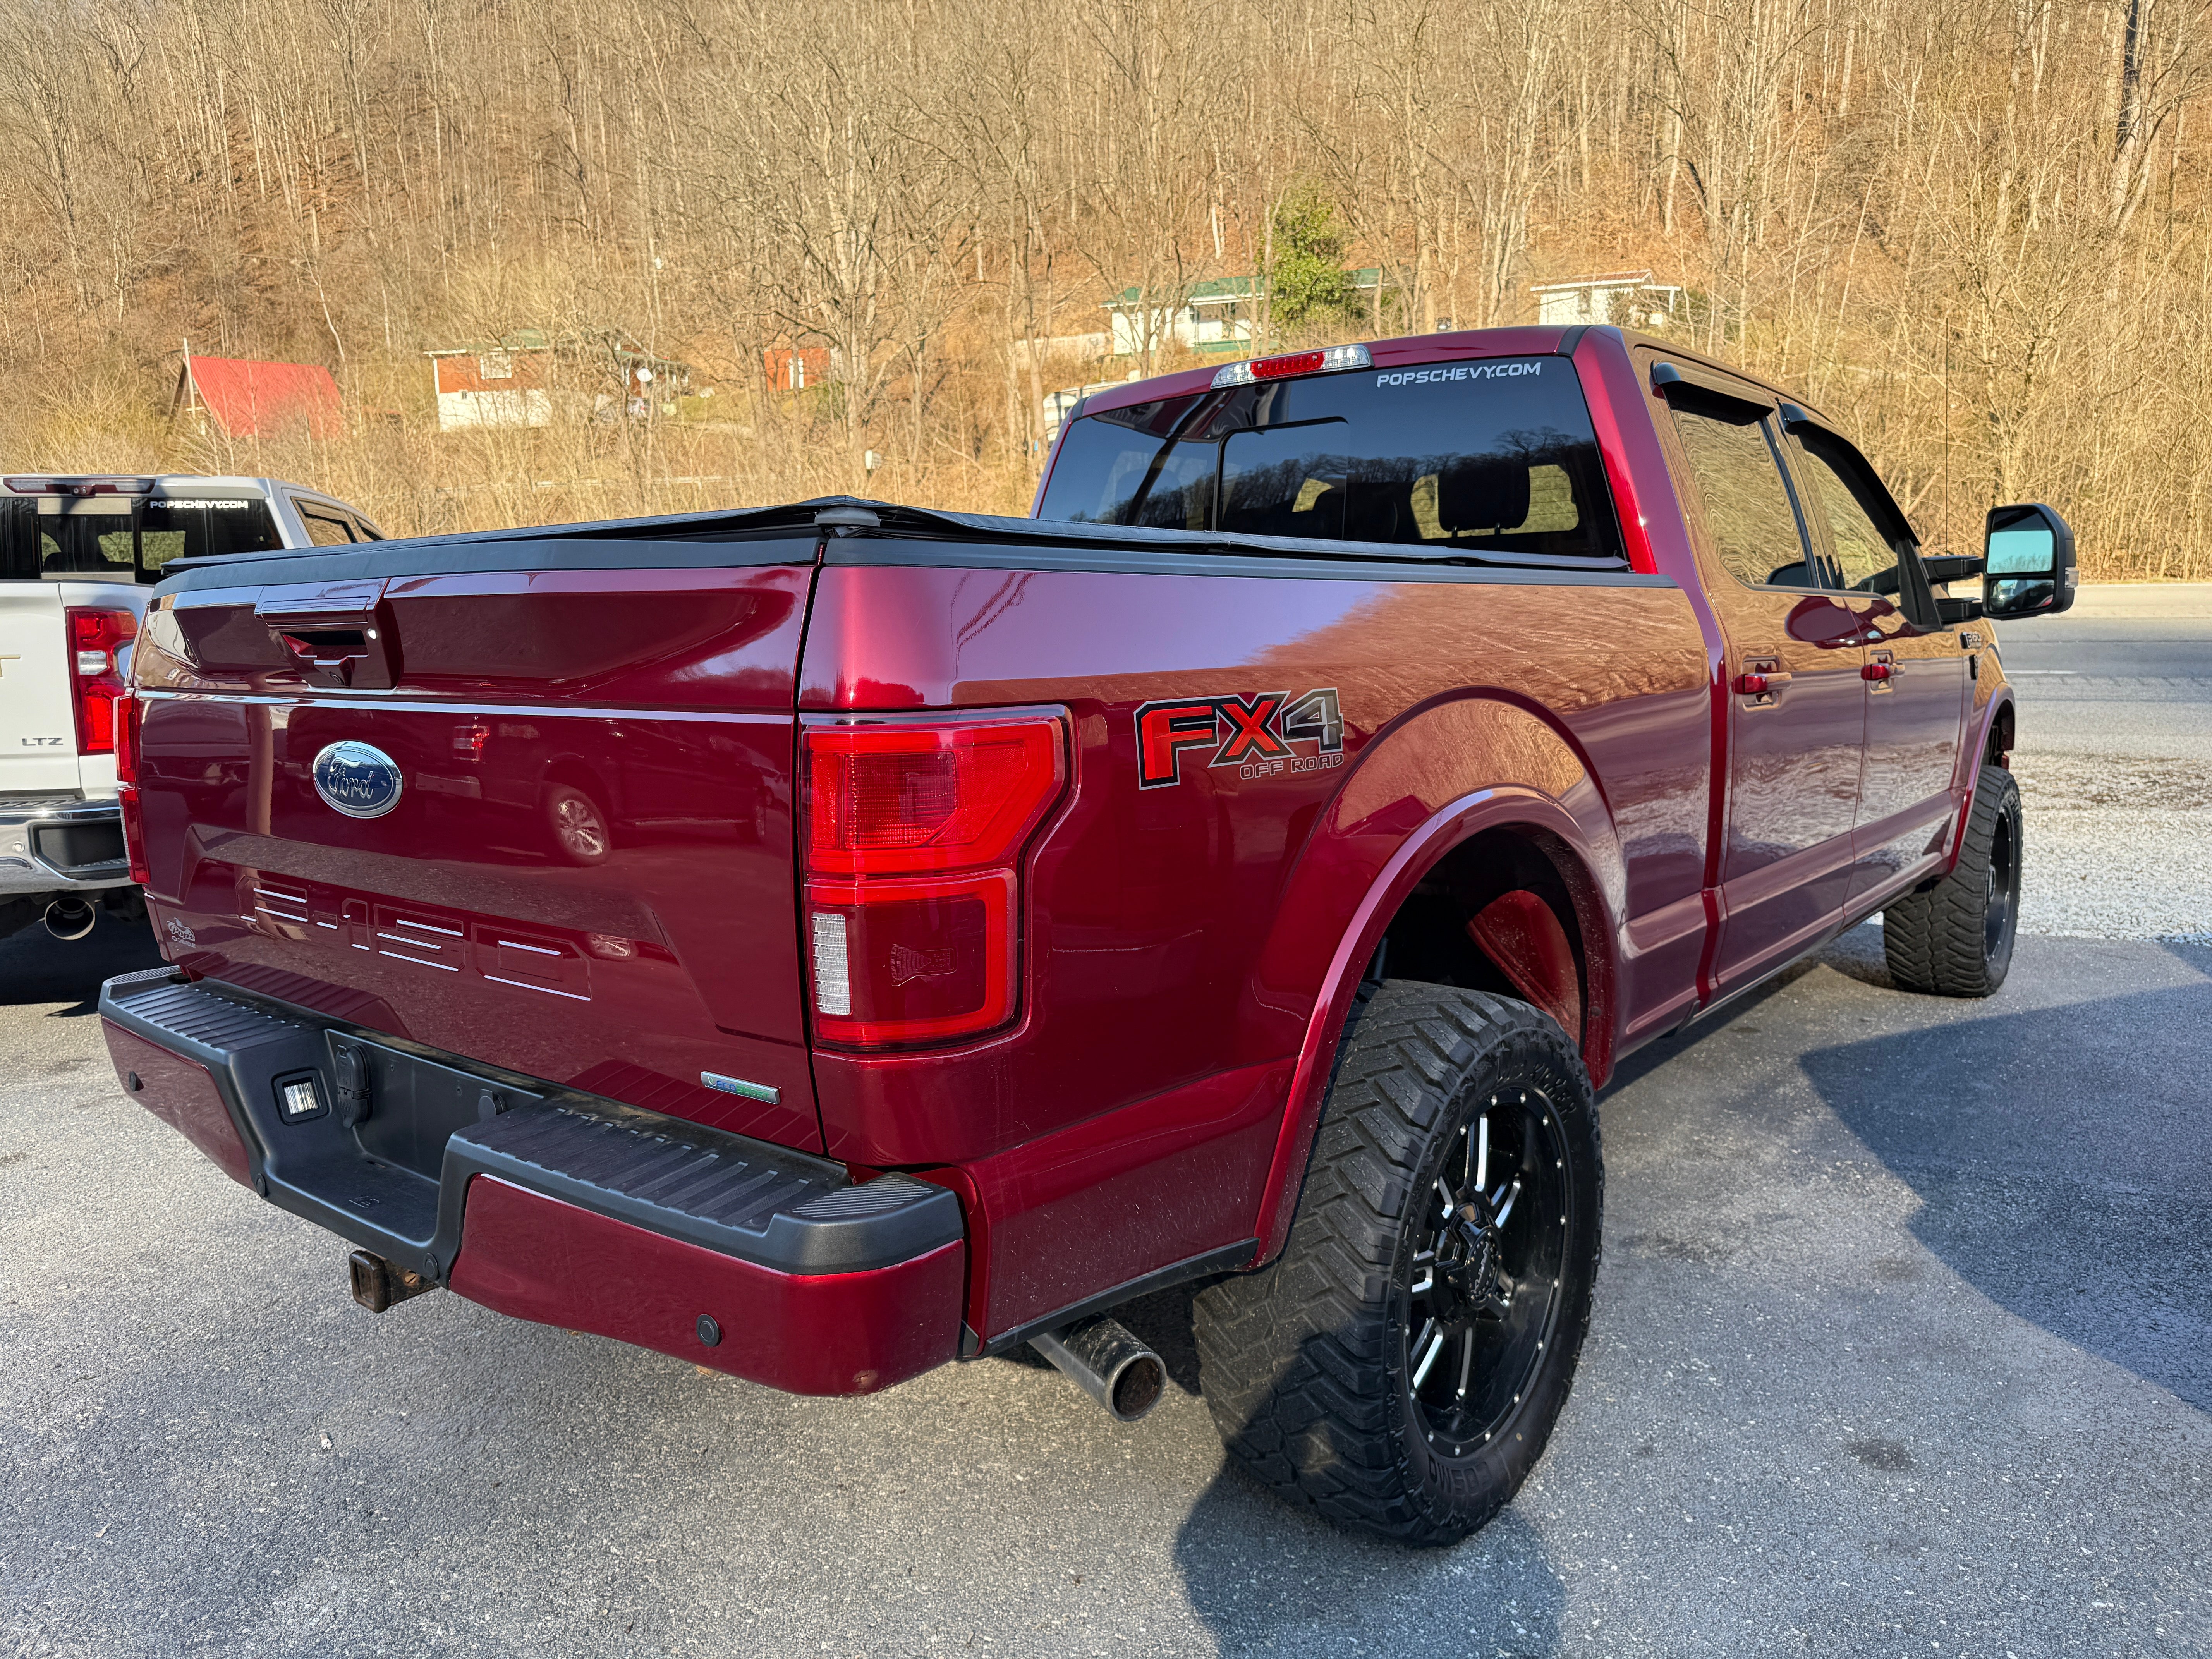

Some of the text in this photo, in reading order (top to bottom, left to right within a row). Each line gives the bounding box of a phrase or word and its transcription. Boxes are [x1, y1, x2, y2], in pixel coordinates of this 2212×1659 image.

[1376, 362, 1542, 388] POPSCHEVY.COM
[150, 500, 249, 509] POPSCHEVY.COM
[22, 737, 63, 746] LTZ
[1133, 687, 1344, 791] FX4
[328, 756, 374, 799] Ford
[1240, 753, 1344, 780] OFF ROAD
